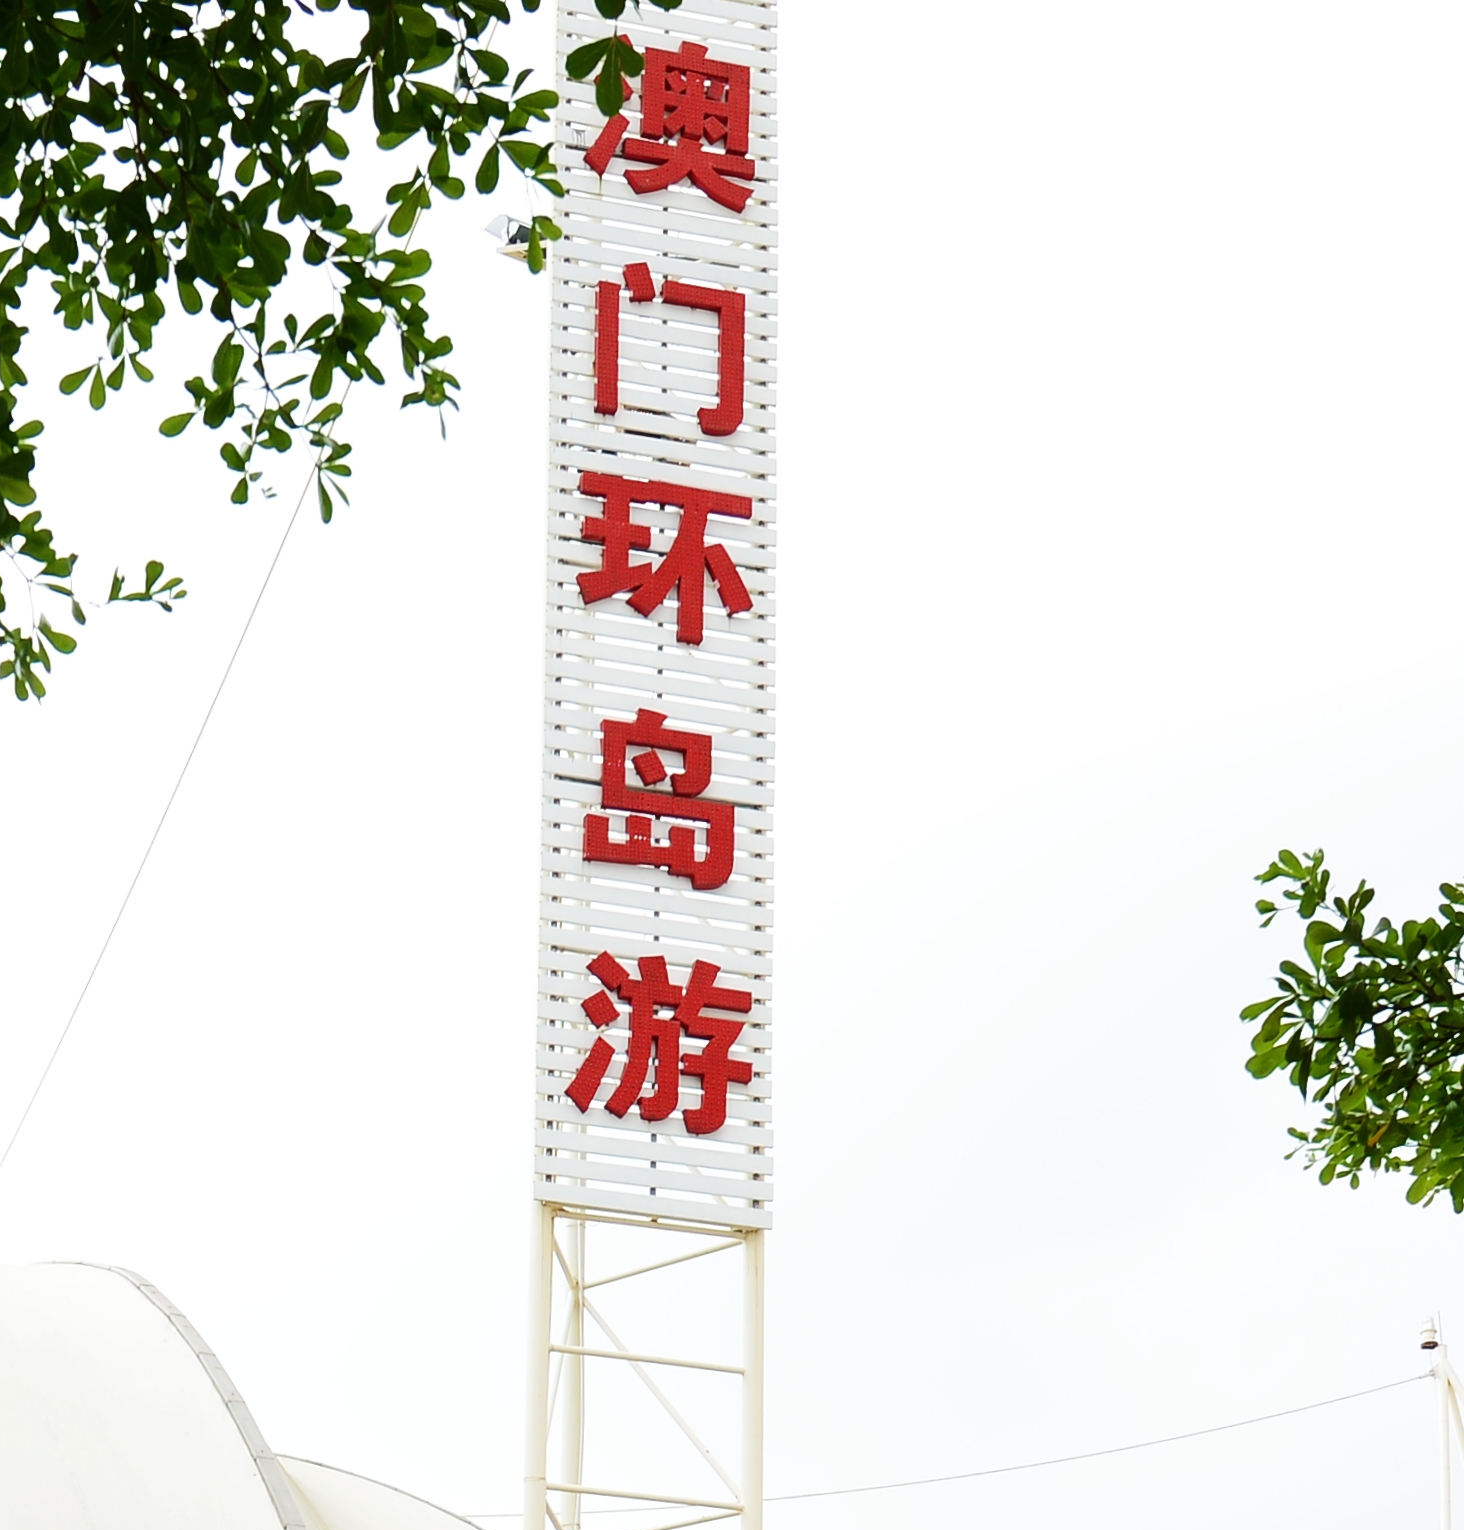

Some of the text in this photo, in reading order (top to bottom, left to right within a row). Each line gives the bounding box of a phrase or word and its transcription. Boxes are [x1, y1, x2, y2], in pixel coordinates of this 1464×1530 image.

[564, 34, 756, 1136] 澳门环岛游
